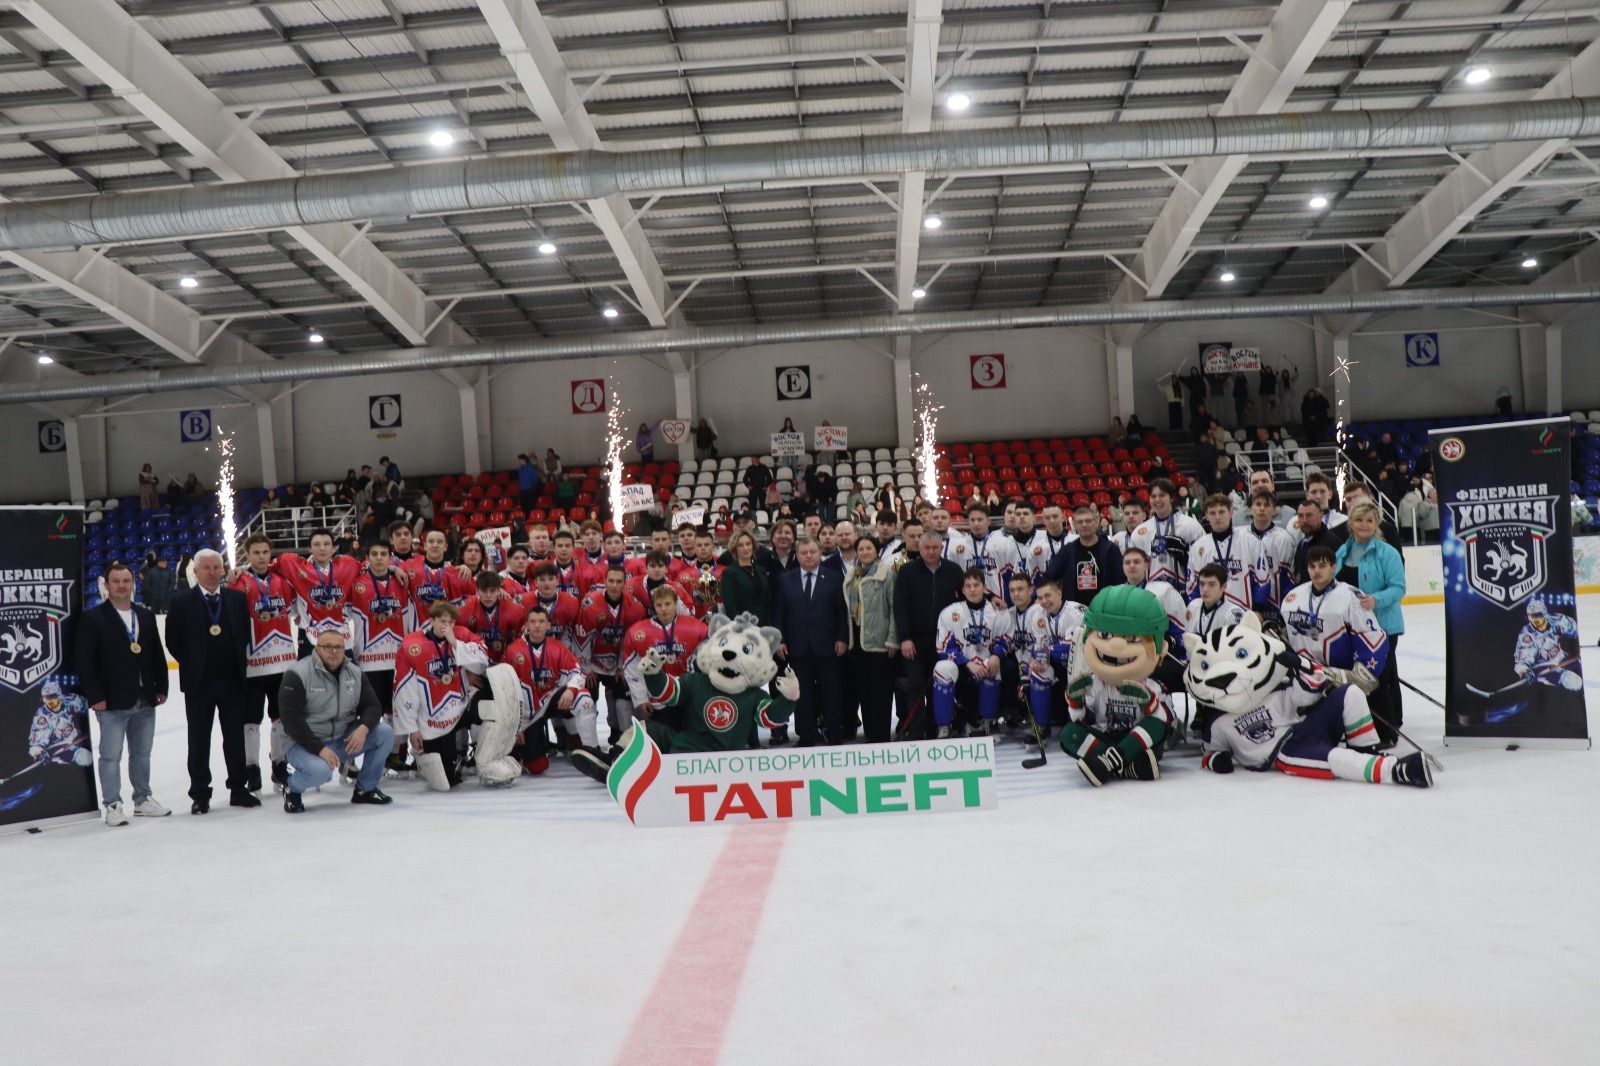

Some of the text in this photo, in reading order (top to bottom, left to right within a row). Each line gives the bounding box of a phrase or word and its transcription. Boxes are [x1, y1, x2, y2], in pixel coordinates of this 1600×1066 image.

[580, 387, 597, 408] Д
[189, 416, 204, 434] В
[1456, 483, 1548, 501] ФЕДЕРАЦИЯ
[1458, 500, 1549, 529] ХОККЕЯ
[1481, 526, 1527, 534] РЕСПУБЛИКИ
[1484, 531, 1524, 539] ТАТАРСТАН
[0, 584, 63, 607] ККЕЯ
[1366, 618, 1377, 631] 2
[676, 743, 989, 775] БЛАГОТВОРИТЕЛЬНЫЙ ФОНД
[675, 769, 992, 822] TATNEFT
